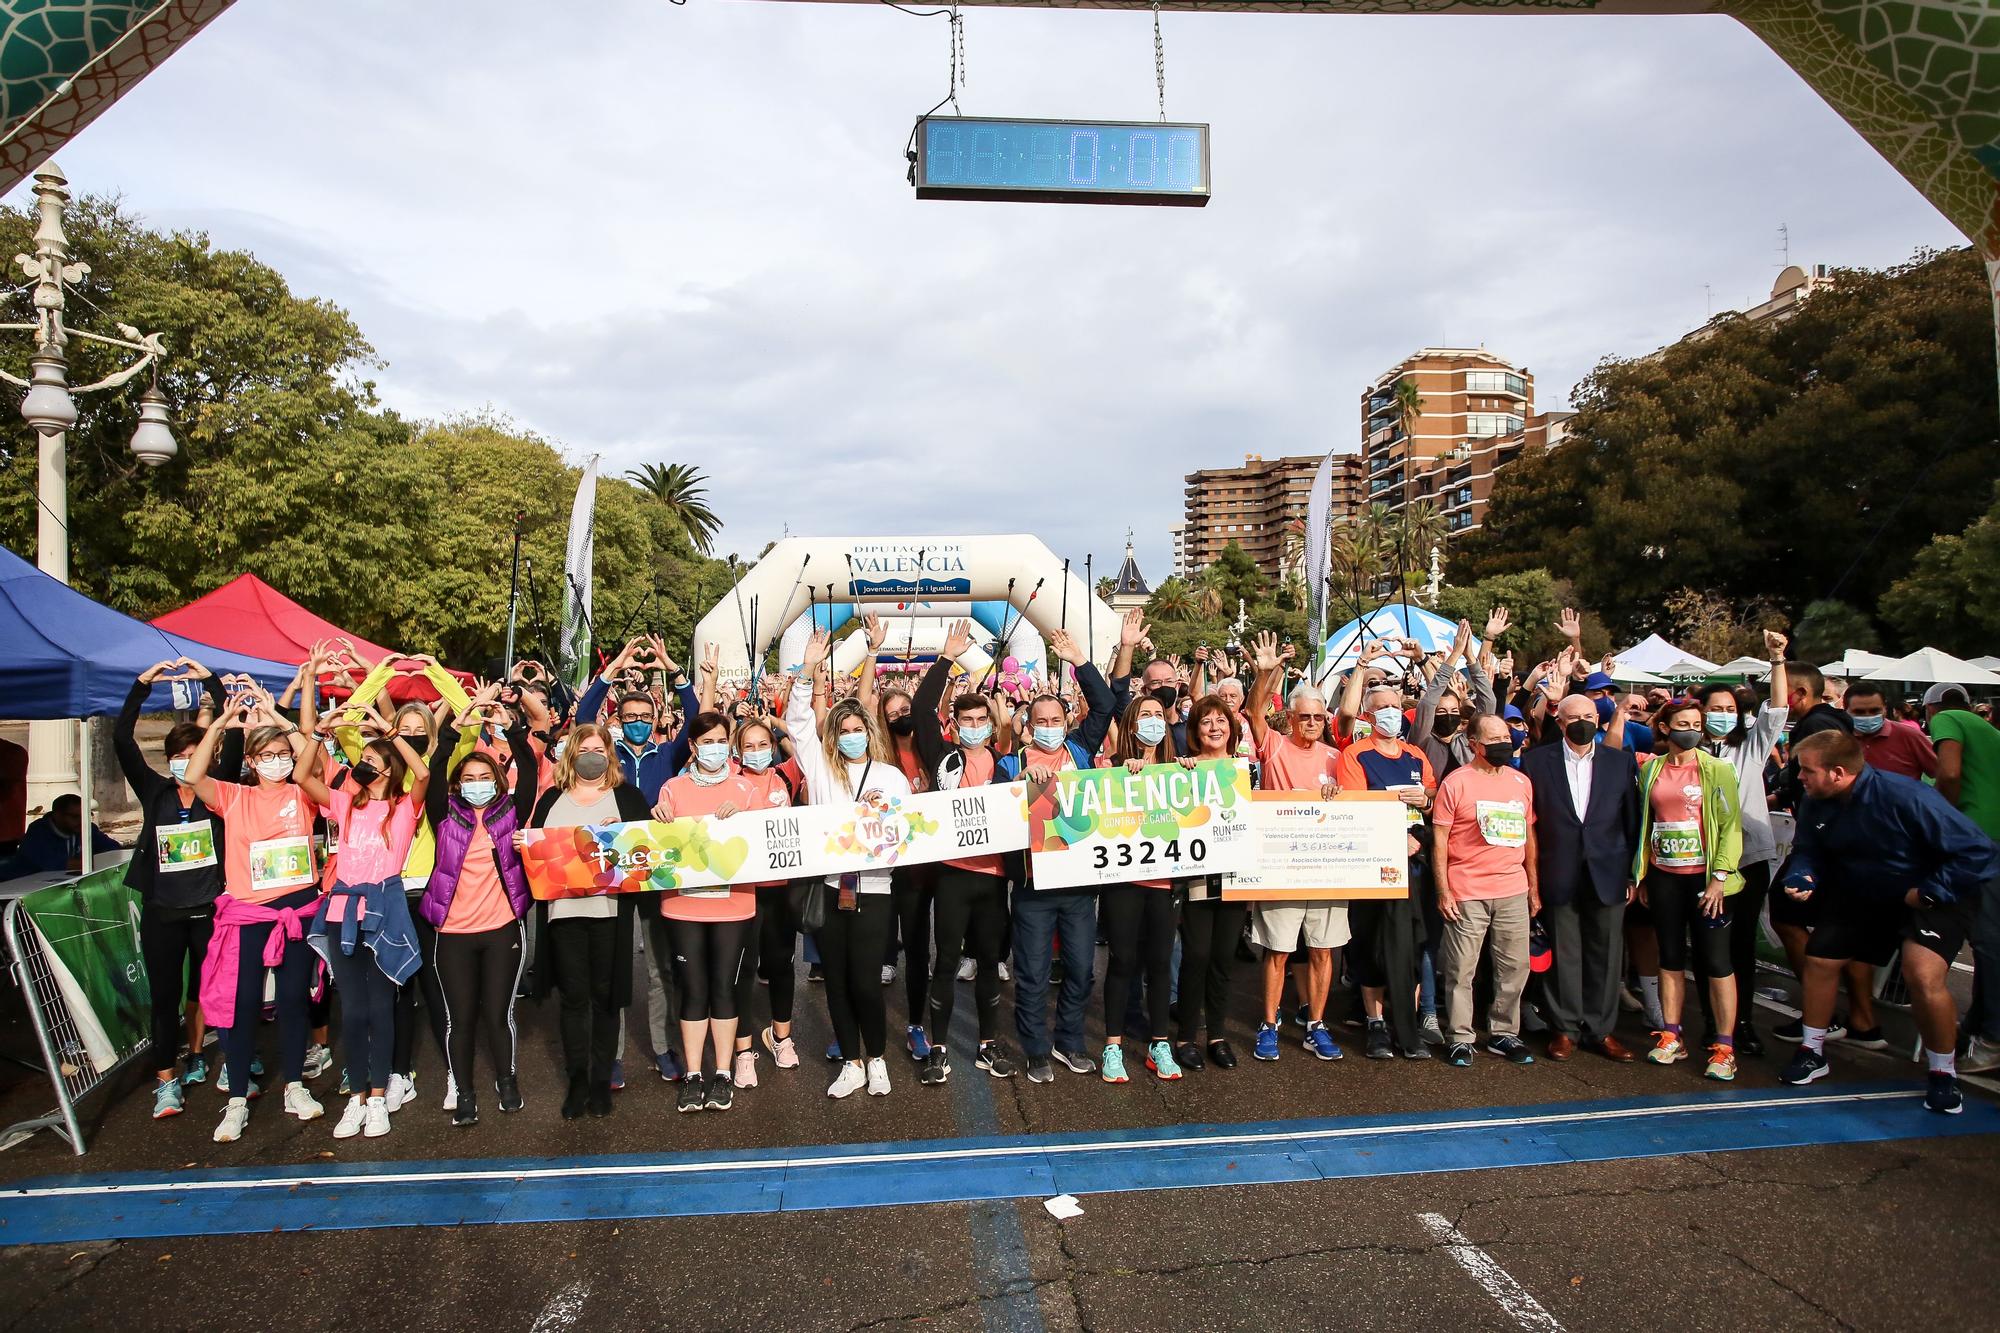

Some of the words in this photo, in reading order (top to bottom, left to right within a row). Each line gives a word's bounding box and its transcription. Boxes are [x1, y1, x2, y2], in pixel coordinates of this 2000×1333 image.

[863, 585, 895, 593] Joventut,
[930, 584, 957, 593] Igualtat
[719, 666, 749, 677] ència
[1055, 770, 1225, 818] VALENCIA
[952, 796, 986, 817] RUN
[1276, 807, 1321, 816] umivale
[765, 817, 800, 839] RUN
[954, 816, 988, 828] CANCER
[1103, 814, 1136, 828] CONTRA
[1138, 814, 1148, 825] EL
[1149, 811, 1177, 825] CANCE
[1231, 824, 1247, 832] AECC
[862, 821, 883, 840] YO
[956, 827, 989, 847] 2021
[1213, 825, 1231, 837] RUN
[181, 839, 200, 857] 40
[766, 837, 801, 850] CANCER
[1661, 837, 1700, 854] 3822
[617, 848, 675, 867] aecc
[768, 850, 803, 869] 2021
[1093, 838, 1207, 869] 33240
[278, 855, 298, 873] 36
